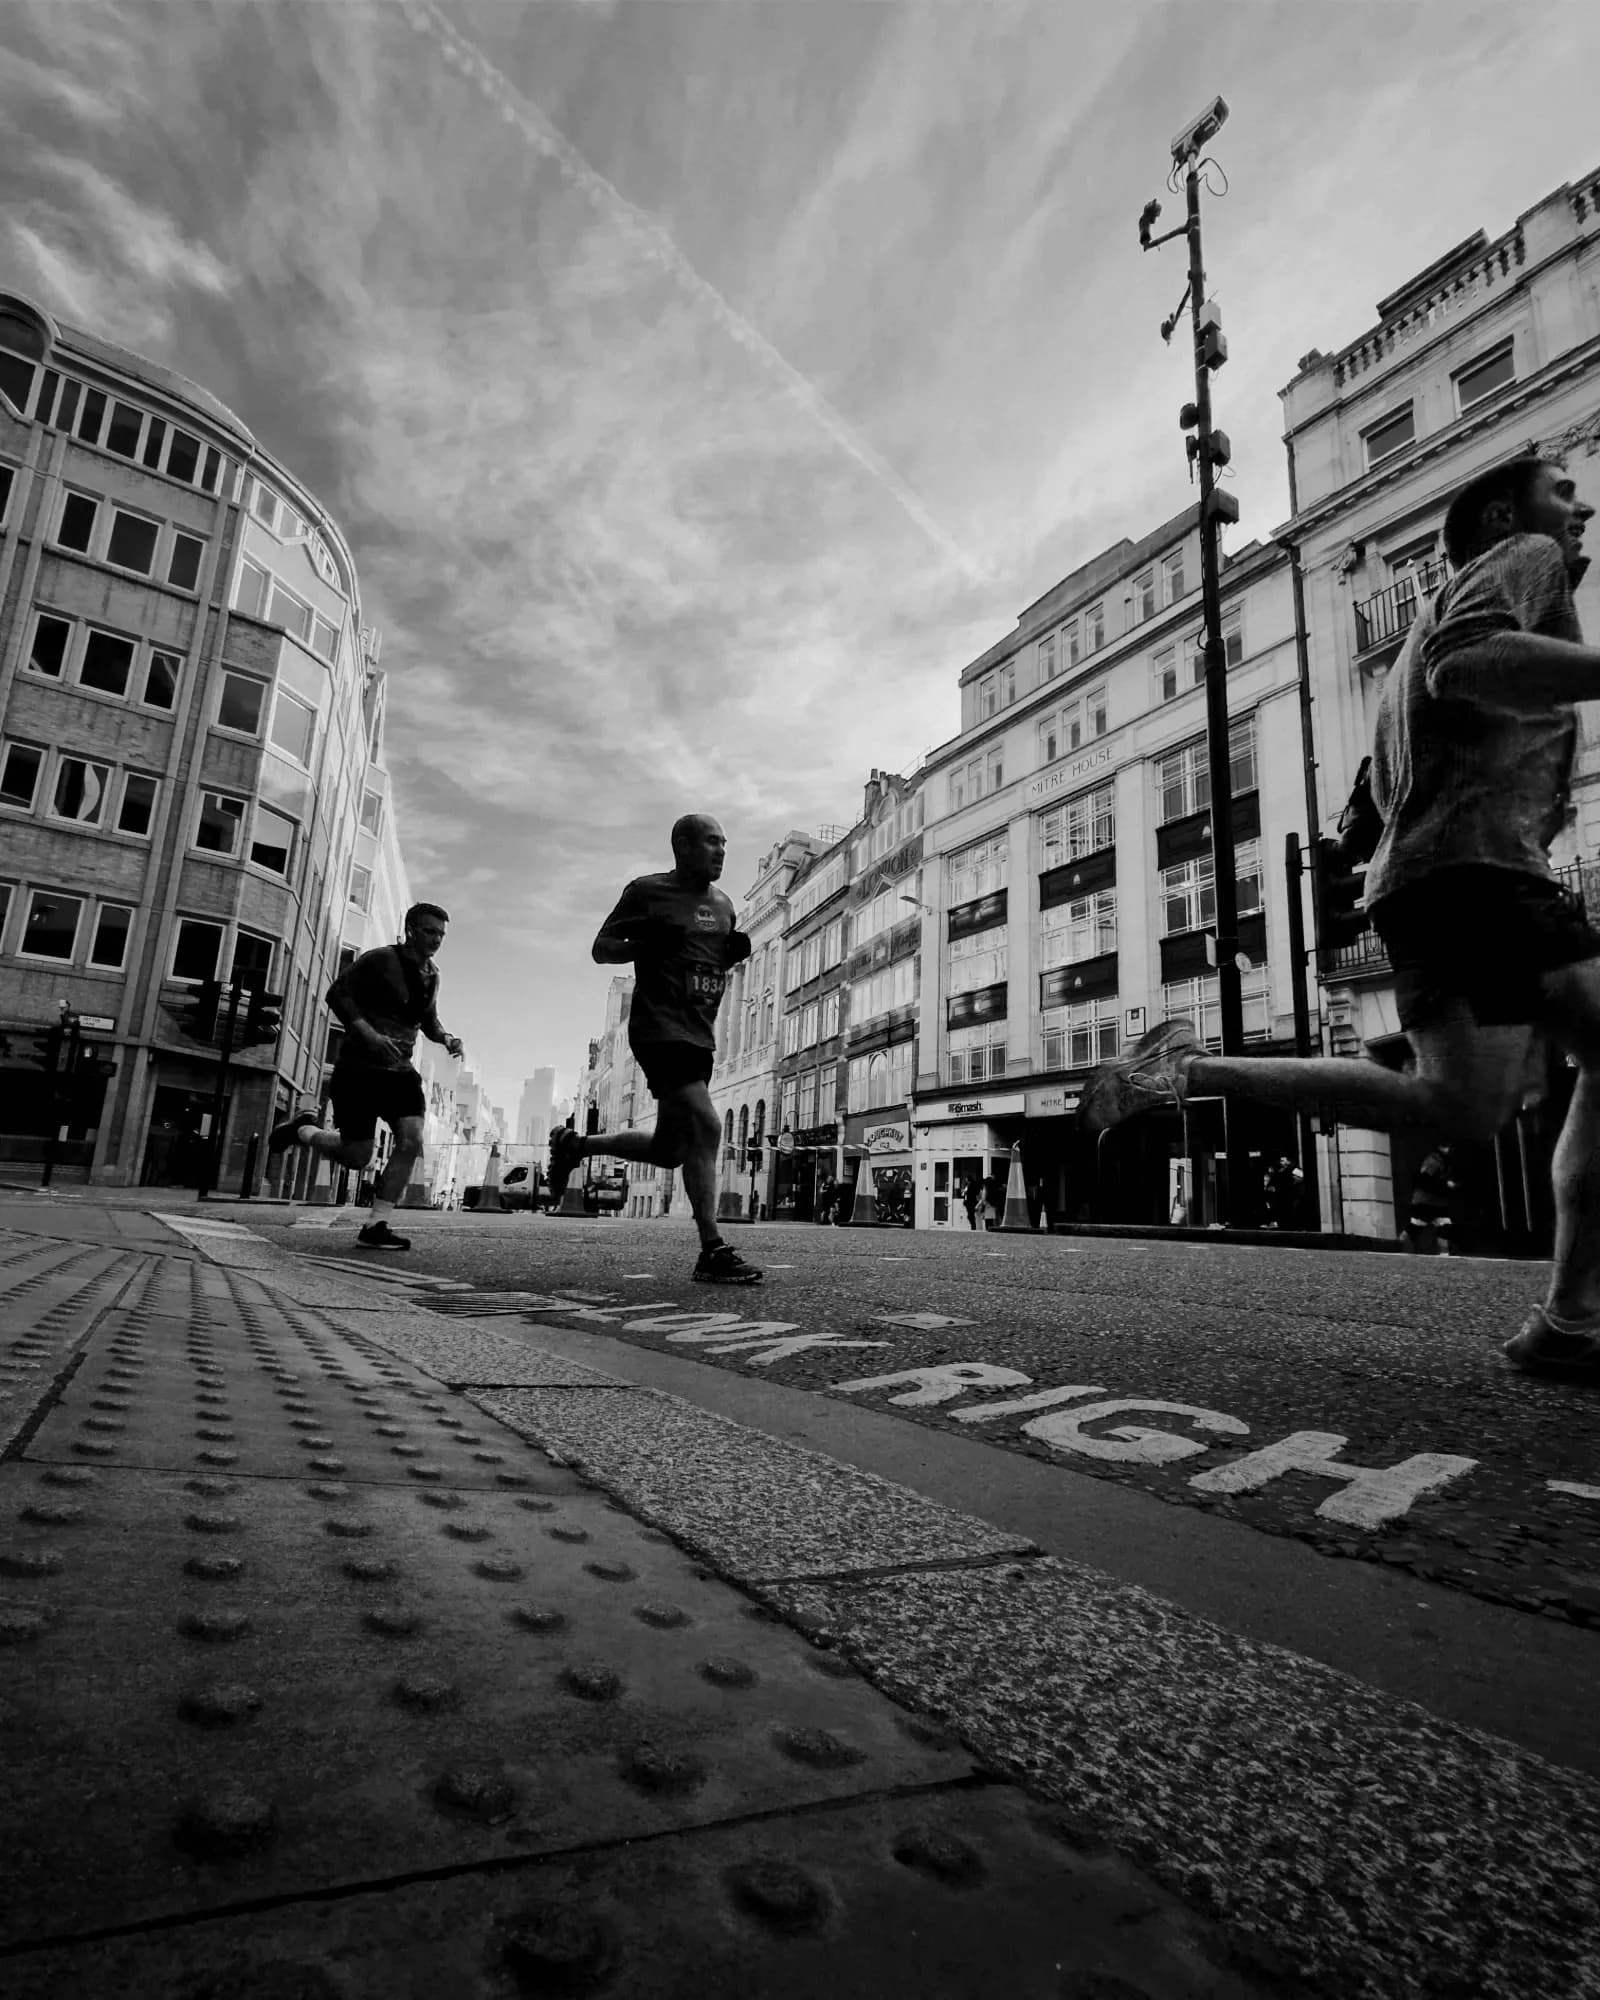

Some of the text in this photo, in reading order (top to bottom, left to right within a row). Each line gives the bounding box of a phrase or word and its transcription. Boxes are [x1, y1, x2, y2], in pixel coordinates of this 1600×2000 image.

[1032, 746, 1113, 795] MITRE HOUSE
[568, 1302, 1600, 1532] LOOK RIGH
